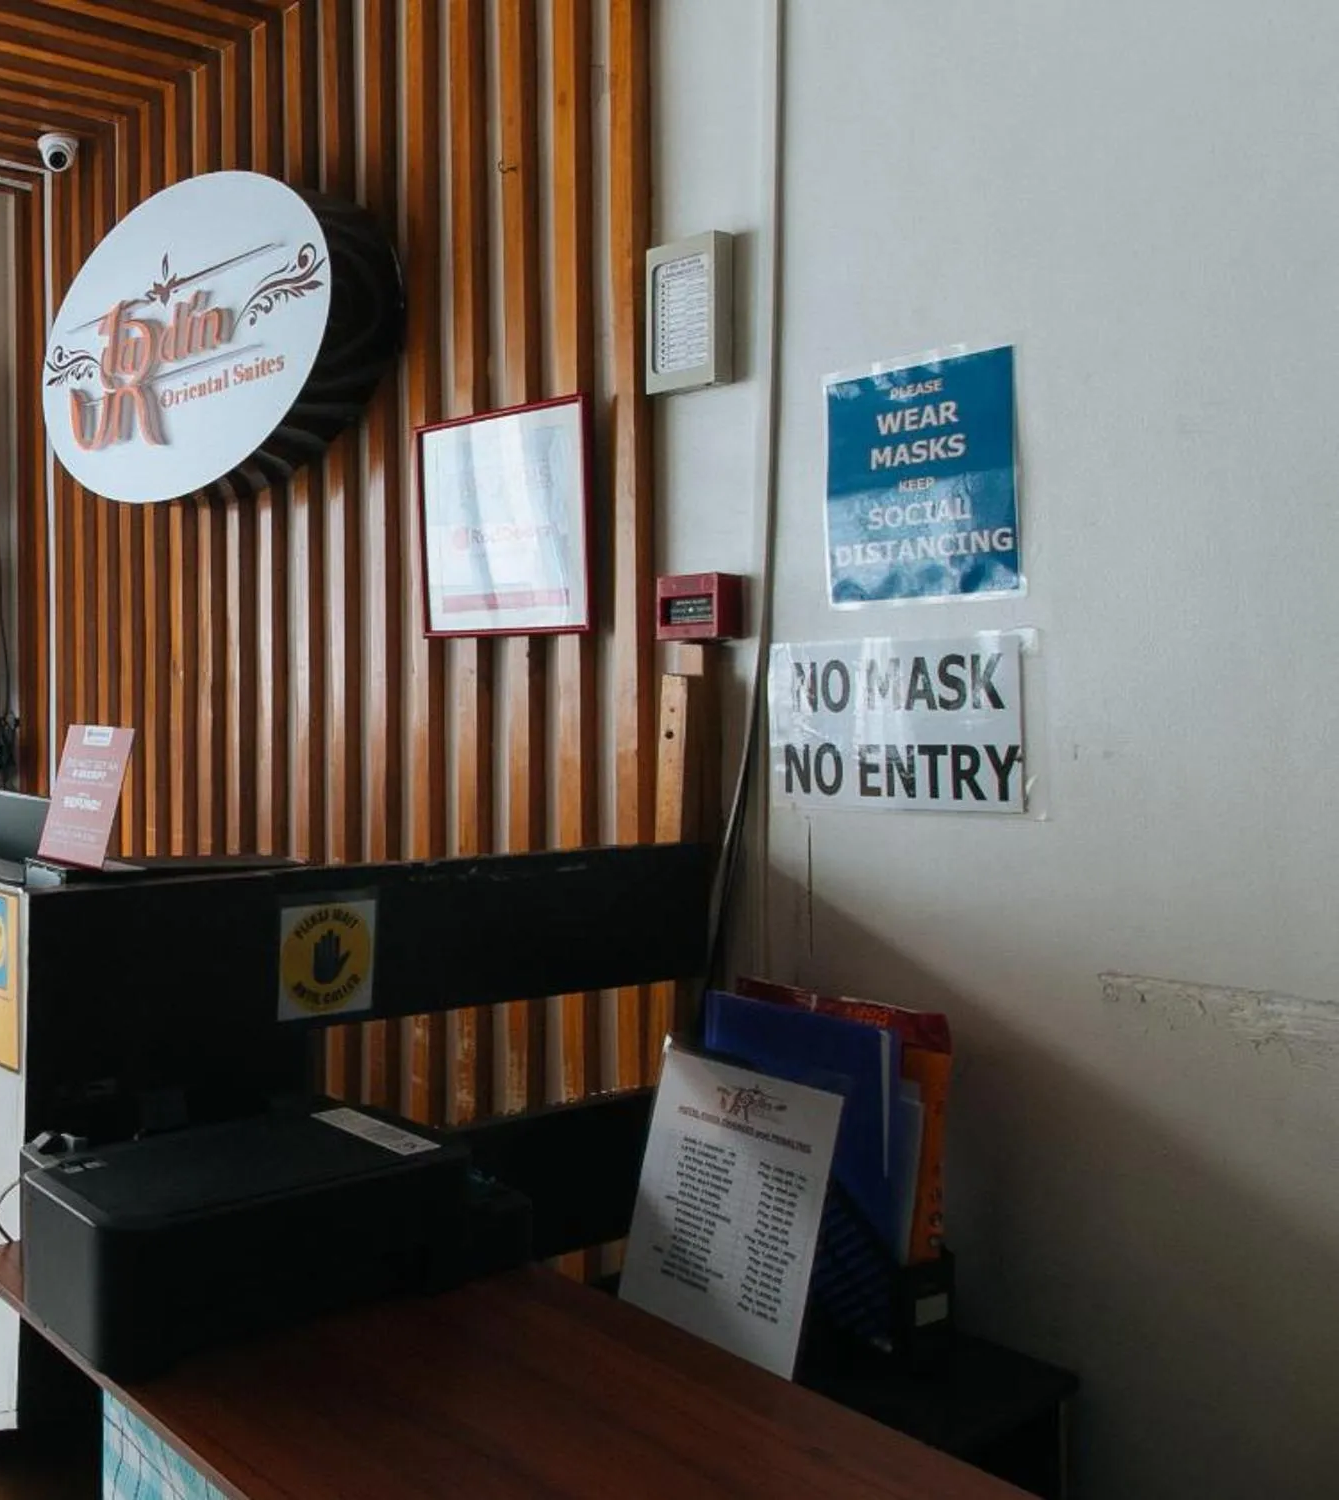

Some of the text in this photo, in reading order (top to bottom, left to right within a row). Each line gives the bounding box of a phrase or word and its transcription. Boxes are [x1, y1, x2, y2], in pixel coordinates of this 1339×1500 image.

[161, 355, 285, 408] Oriental Suites
[890, 379, 943, 400] PLEASE
[876, 401, 959, 436] WEAR
[870, 434, 966, 470] MASKS
[899, 477, 935, 493] KEEP
[867, 497, 972, 530] SOCIAL
[835, 527, 1014, 568] DISTANCING
[792, 653, 1006, 713] NO MASK
[784, 743, 1023, 801] NO ENTRY
